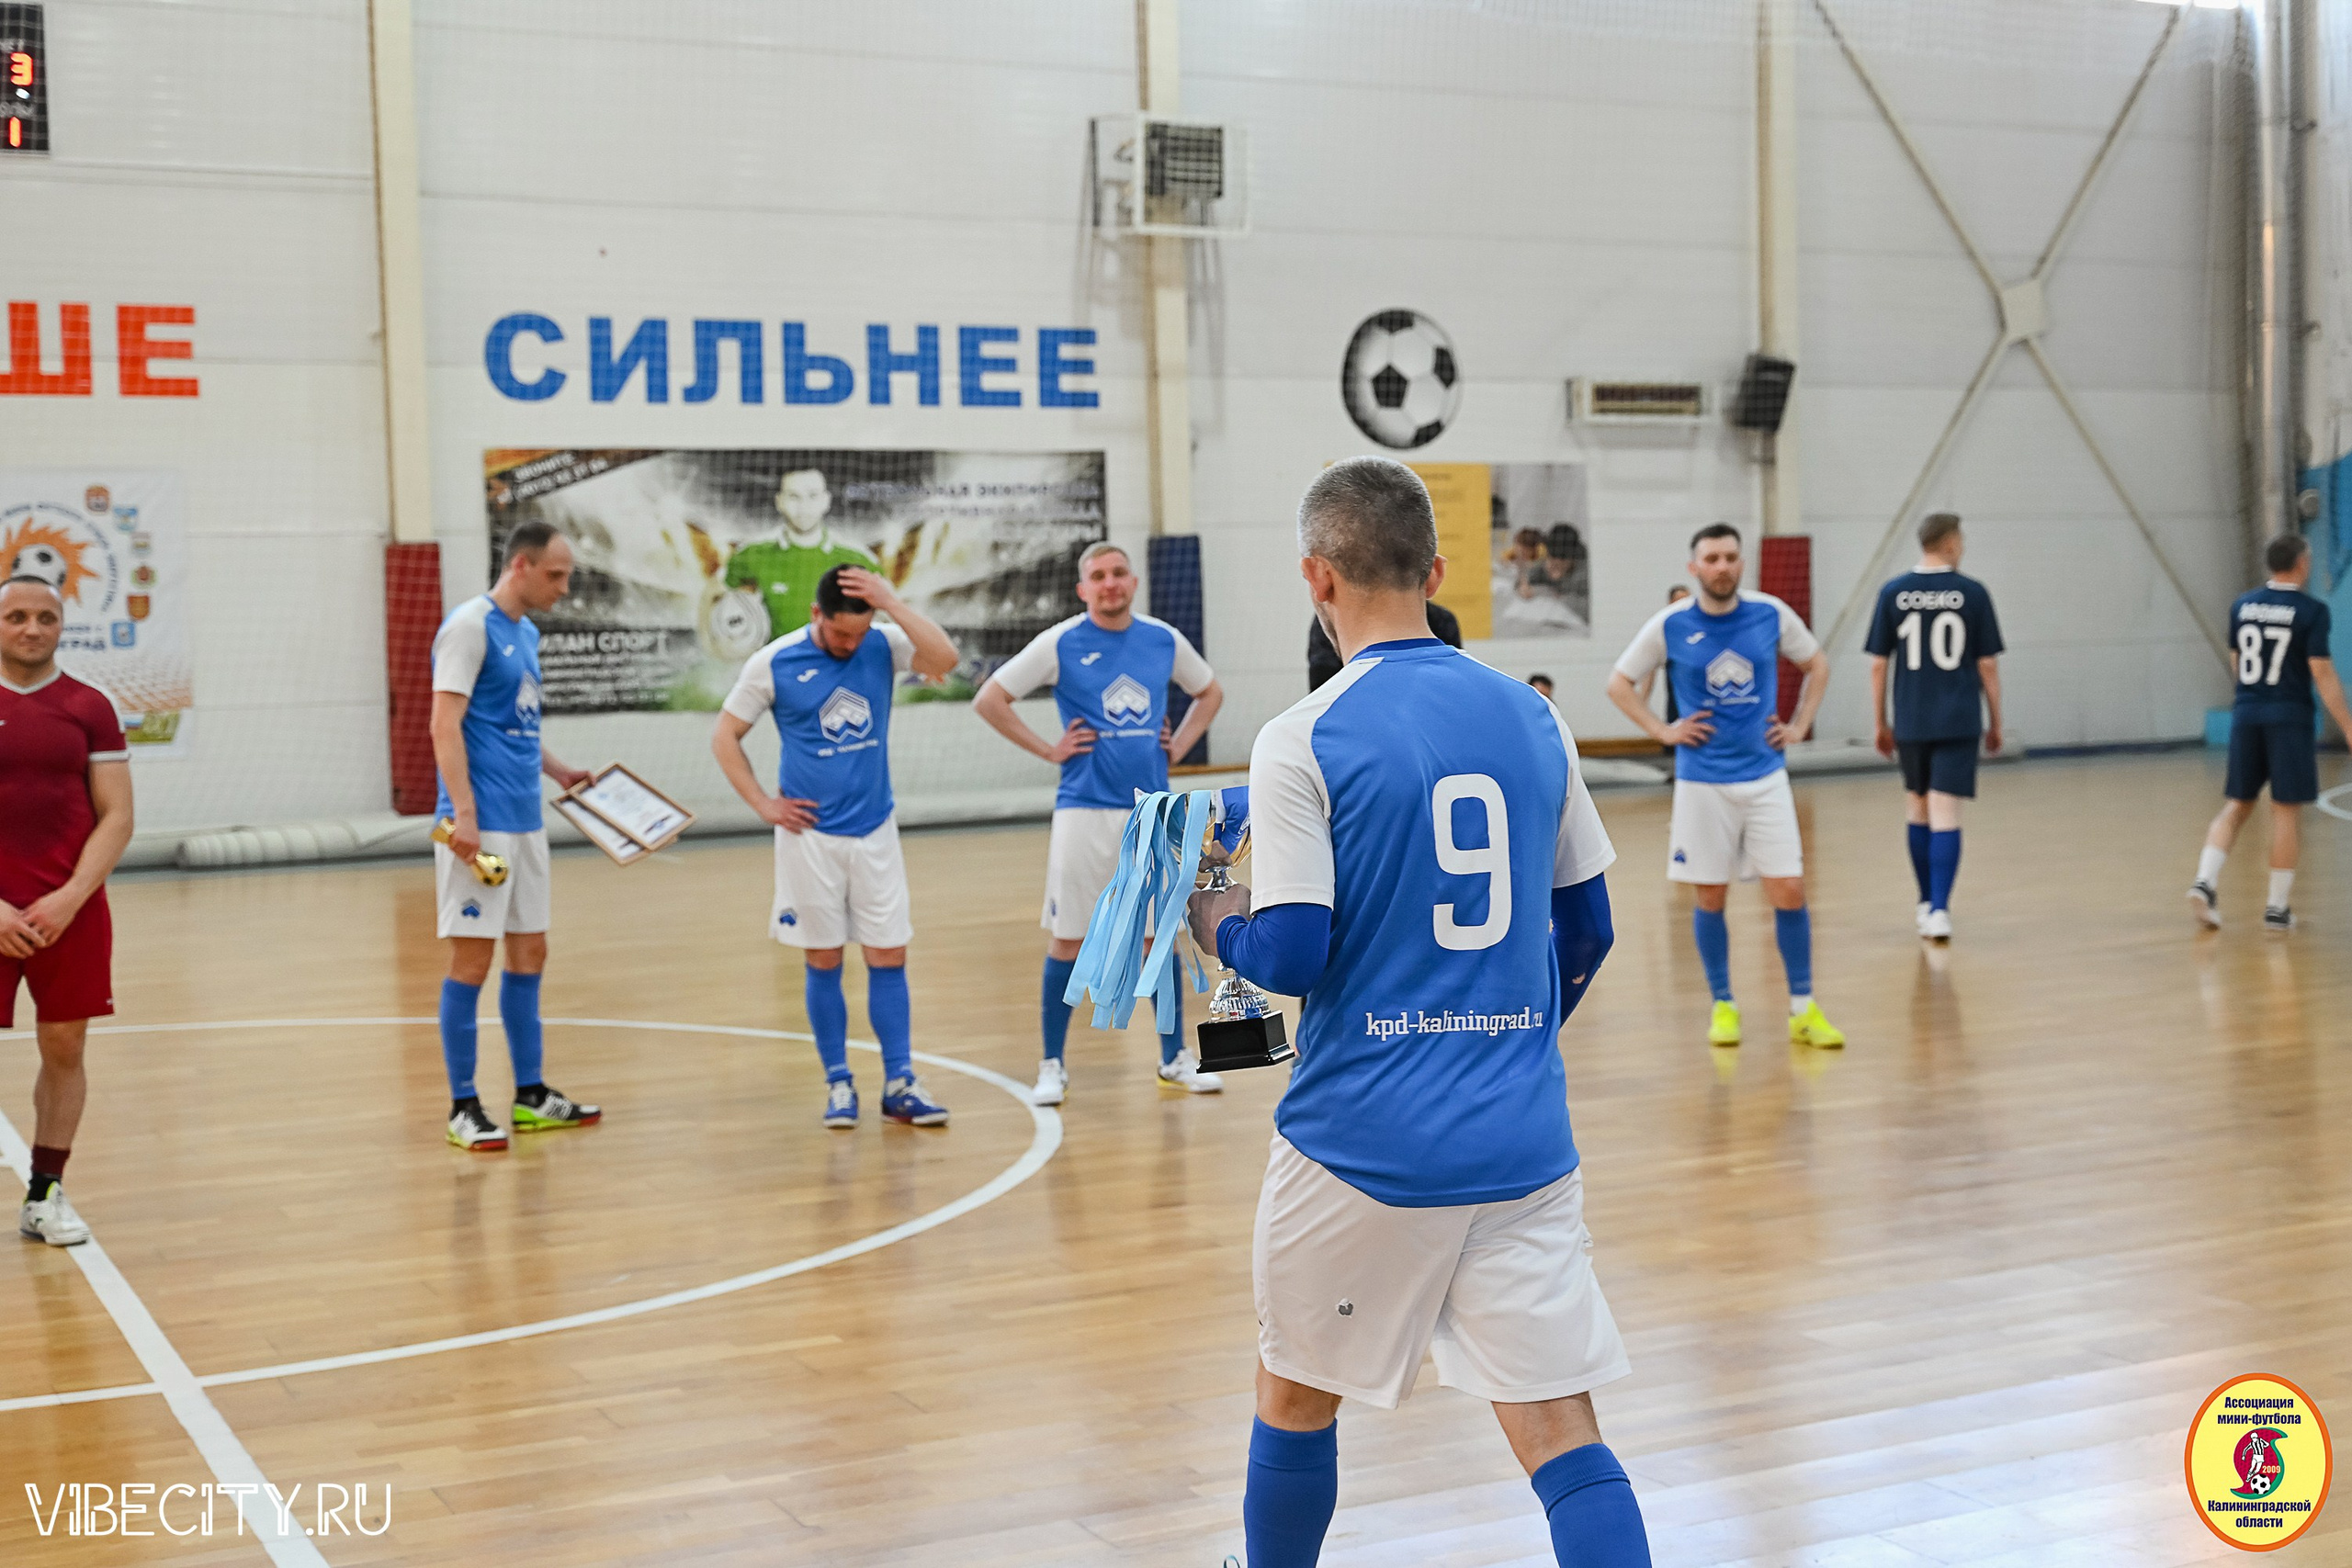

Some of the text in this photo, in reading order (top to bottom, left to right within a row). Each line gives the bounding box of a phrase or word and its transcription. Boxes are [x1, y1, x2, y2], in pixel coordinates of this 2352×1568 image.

[10, 52, 33, 86] 3
[0, 301, 199, 397] ШЕ
[484, 312, 1100, 409] СИЛЬНЕЕ
[1896, 611, 1966, 671] 10
[2237, 624, 2292, 685] 87
[1431, 773, 1512, 951] 9
